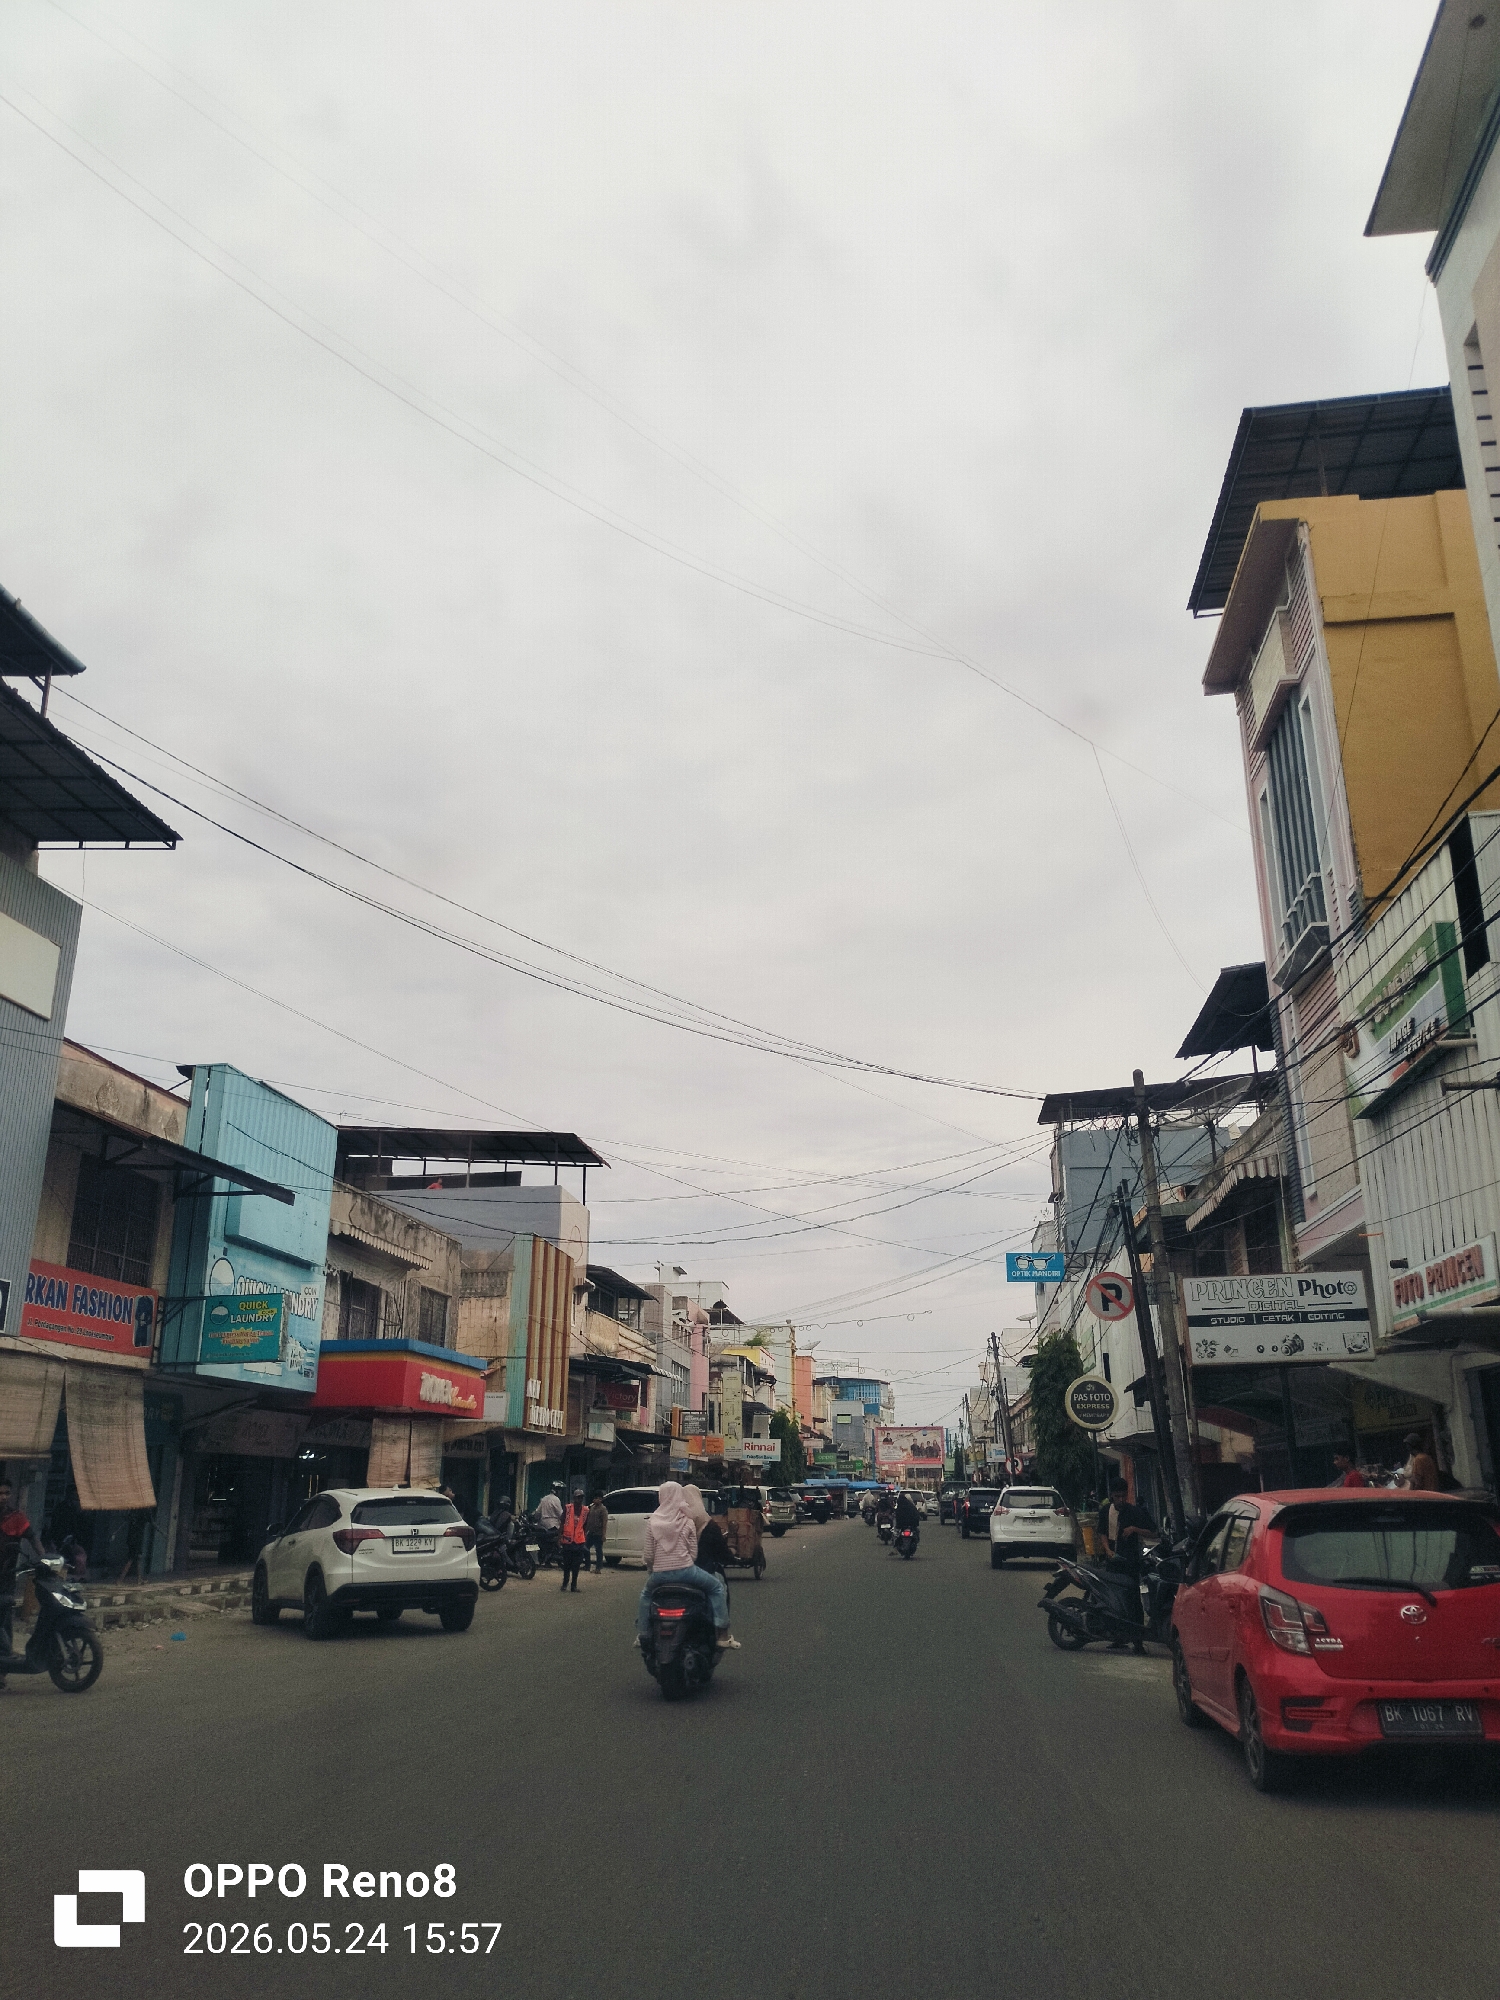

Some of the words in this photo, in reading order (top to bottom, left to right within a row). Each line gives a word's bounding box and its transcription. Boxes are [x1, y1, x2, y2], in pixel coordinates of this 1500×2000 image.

[1190, 1277, 1294, 1303] PRINCEN
[71, 1283, 134, 1325] FASHION
[239, 1301, 268, 1311] QUICK
[1248, 1300, 1305, 1311] DIGITAL
[230, 1313, 275, 1324] LAUNDRY
[1211, 1316, 1246, 1324] STUDIO
[1262, 1314, 1295, 1322] CETAK
[1308, 1312, 1345, 1320] EDITING
[1073, 1393, 1088, 1401] PAS
[1090, 1393, 1111, 1401] FOTO
[744, 1442, 776, 1452] Rinnai
[1384, 1705, 1403, 1722] BK
[1411, 1706, 1444, 1722] 1067
[1455, 1705, 1474, 1722] RV
